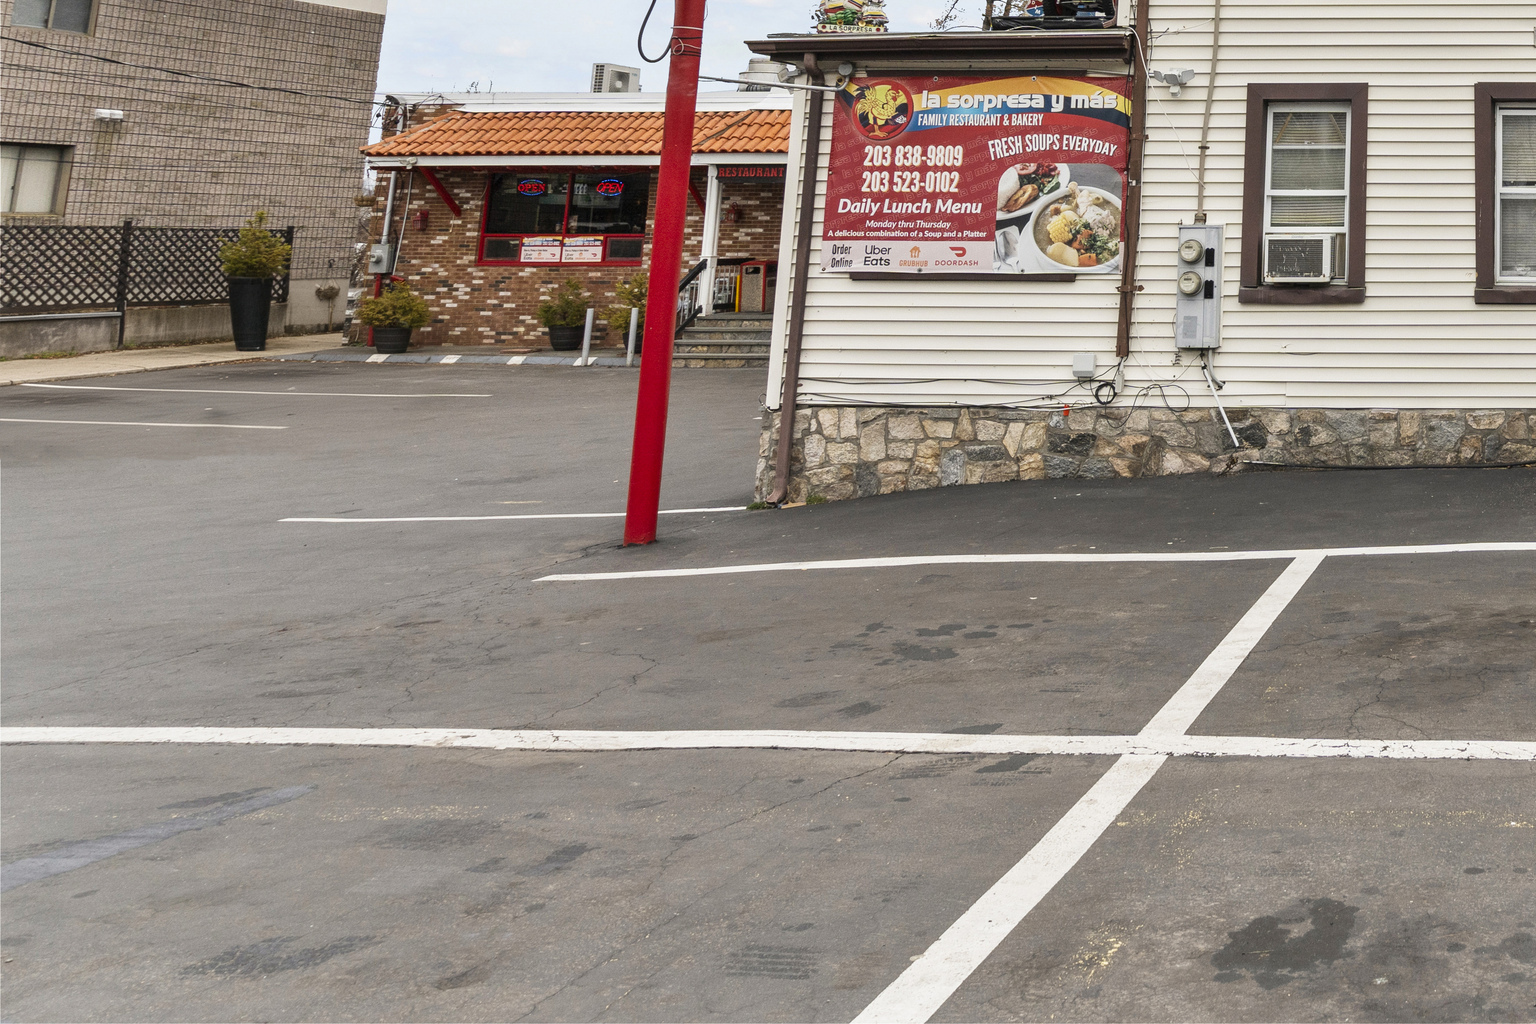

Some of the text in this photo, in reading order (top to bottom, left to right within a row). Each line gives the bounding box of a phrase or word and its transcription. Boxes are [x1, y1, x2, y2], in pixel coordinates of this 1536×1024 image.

[921, 90, 1117, 112] la sorpresa y más
[918, 114, 1044, 126] FAMILY RESTAURANT & BAKERY
[988, 134, 1118, 161] FRESH SOUPS EVERYDAY
[863, 145, 963, 167] 203 838-9809
[718, 167, 784, 177] RESTAURANT
[861, 171, 960, 193] 203 523-0102
[517, 183, 546, 192] OPEN
[596, 183, 624, 193] OPEN
[837, 198, 982, 216] Daily Lunch Menu
[865, 220, 951, 229] Monday thru Thursday
[924, 231, 942, 239] Soup
[832, 244, 852, 255] Order
[864, 245, 892, 255] Uber
[831, 257, 853, 268] Online
[863, 256, 891, 266] Eats
[899, 259, 928, 267] GRUBHUB
